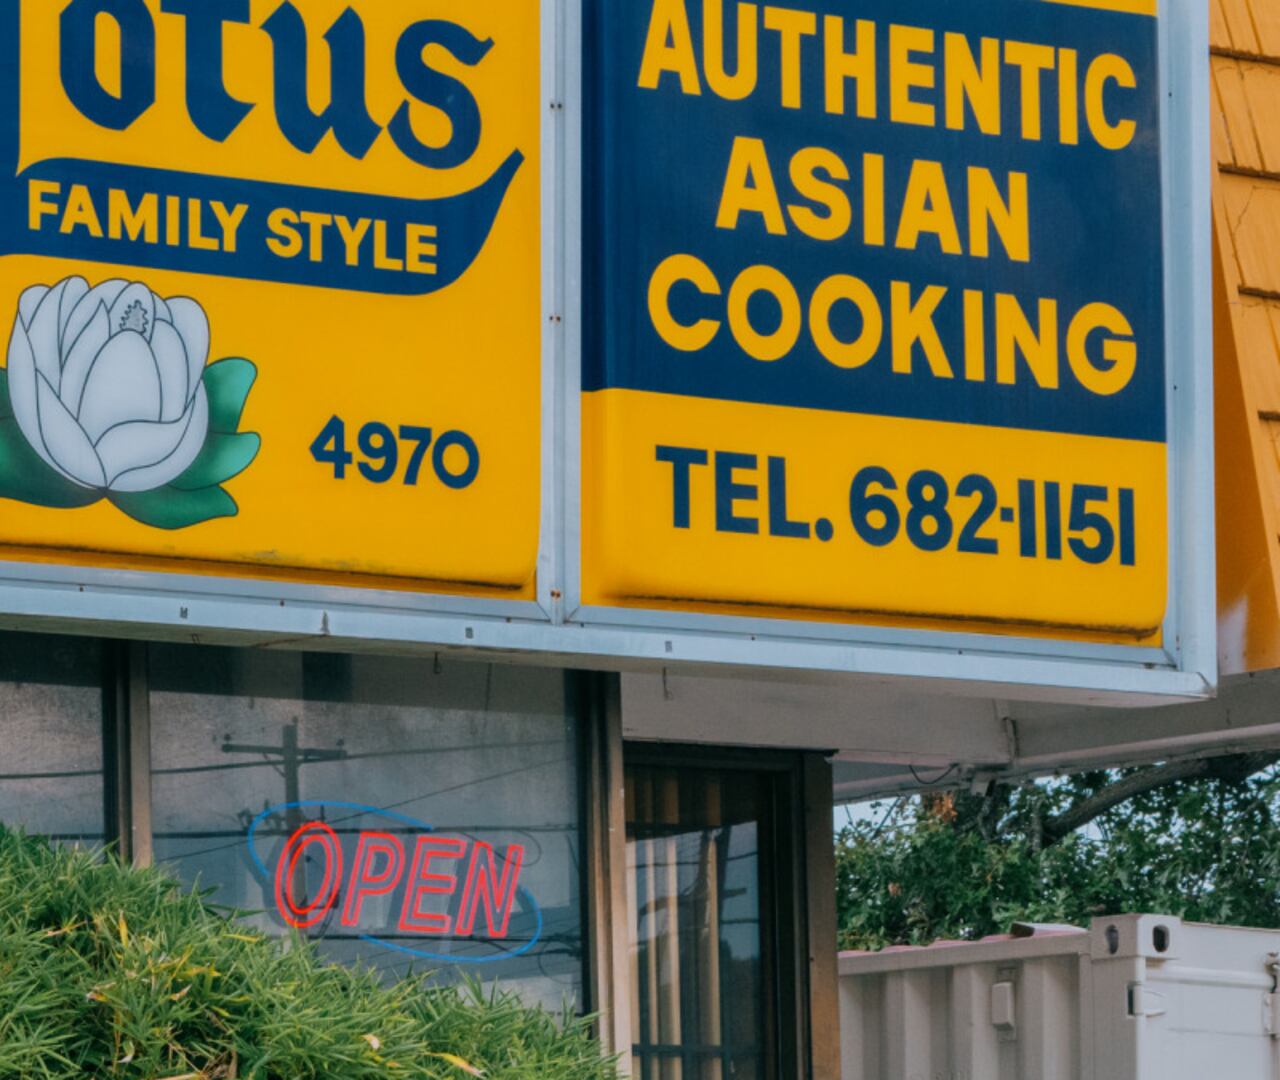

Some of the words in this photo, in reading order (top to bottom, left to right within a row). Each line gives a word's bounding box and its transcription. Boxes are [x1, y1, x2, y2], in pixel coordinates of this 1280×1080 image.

[637, 0, 1137, 150] AUTHENTIC
[28, 179, 248, 253] FAMILY
[266, 207, 437, 275] STYLE
[715, 136, 1030, 263] ASIAN
[647, 253, 1137, 396] COOKING
[309, 415, 480, 490] 4970
[655, 445, 834, 542] TEL.
[849, 466, 1136, 566] 682-1151
[274, 821, 524, 939] OPEN
